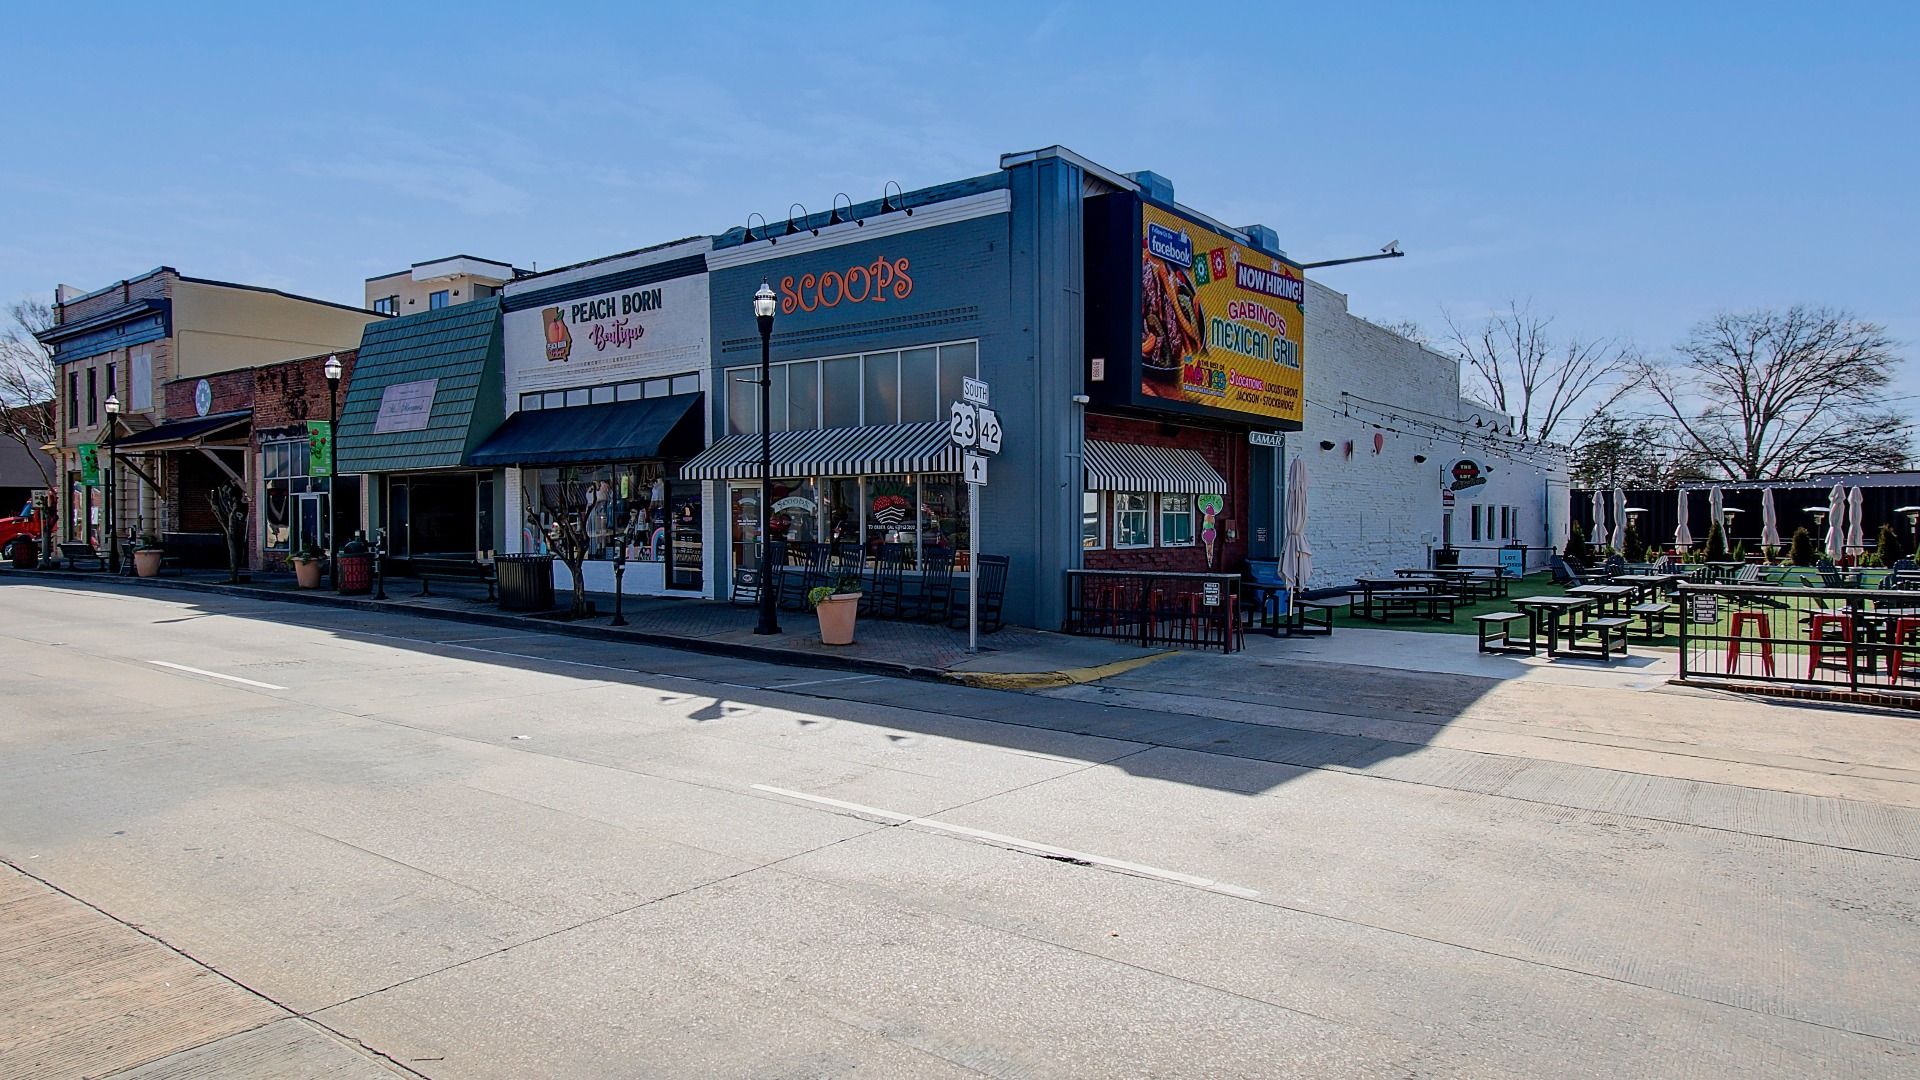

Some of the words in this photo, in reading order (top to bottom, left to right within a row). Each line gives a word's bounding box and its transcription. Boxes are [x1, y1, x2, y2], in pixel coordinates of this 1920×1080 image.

[1152, 235, 1190, 263] facebook
[780, 255, 913, 315] SCOOPS
[1238, 265, 1267, 291] NOW
[1266, 273, 1303, 300] HIRING!
[571, 296, 616, 324] PEACH
[621, 287, 663, 315] BORN
[1228, 301, 1286, 336] GABINO'S
[588, 318, 645, 352] Boutique
[1211, 317, 1270, 360] MEXICAN
[1272, 336, 1300, 369] GRILL
[964, 382, 986, 399] SOUTH
[1229, 368, 1236, 384] 3
[1264, 382, 1283, 395] LOCUST
[1283, 386, 1298, 398] GROVE
[1235, 390, 1260, 404] JACKSON
[1262, 396, 1295, 411] STOCKBRIDGE
[953, 411, 975, 439] 23
[981, 421, 999, 444] 42
[1251, 433, 1282, 446] LAMAR
